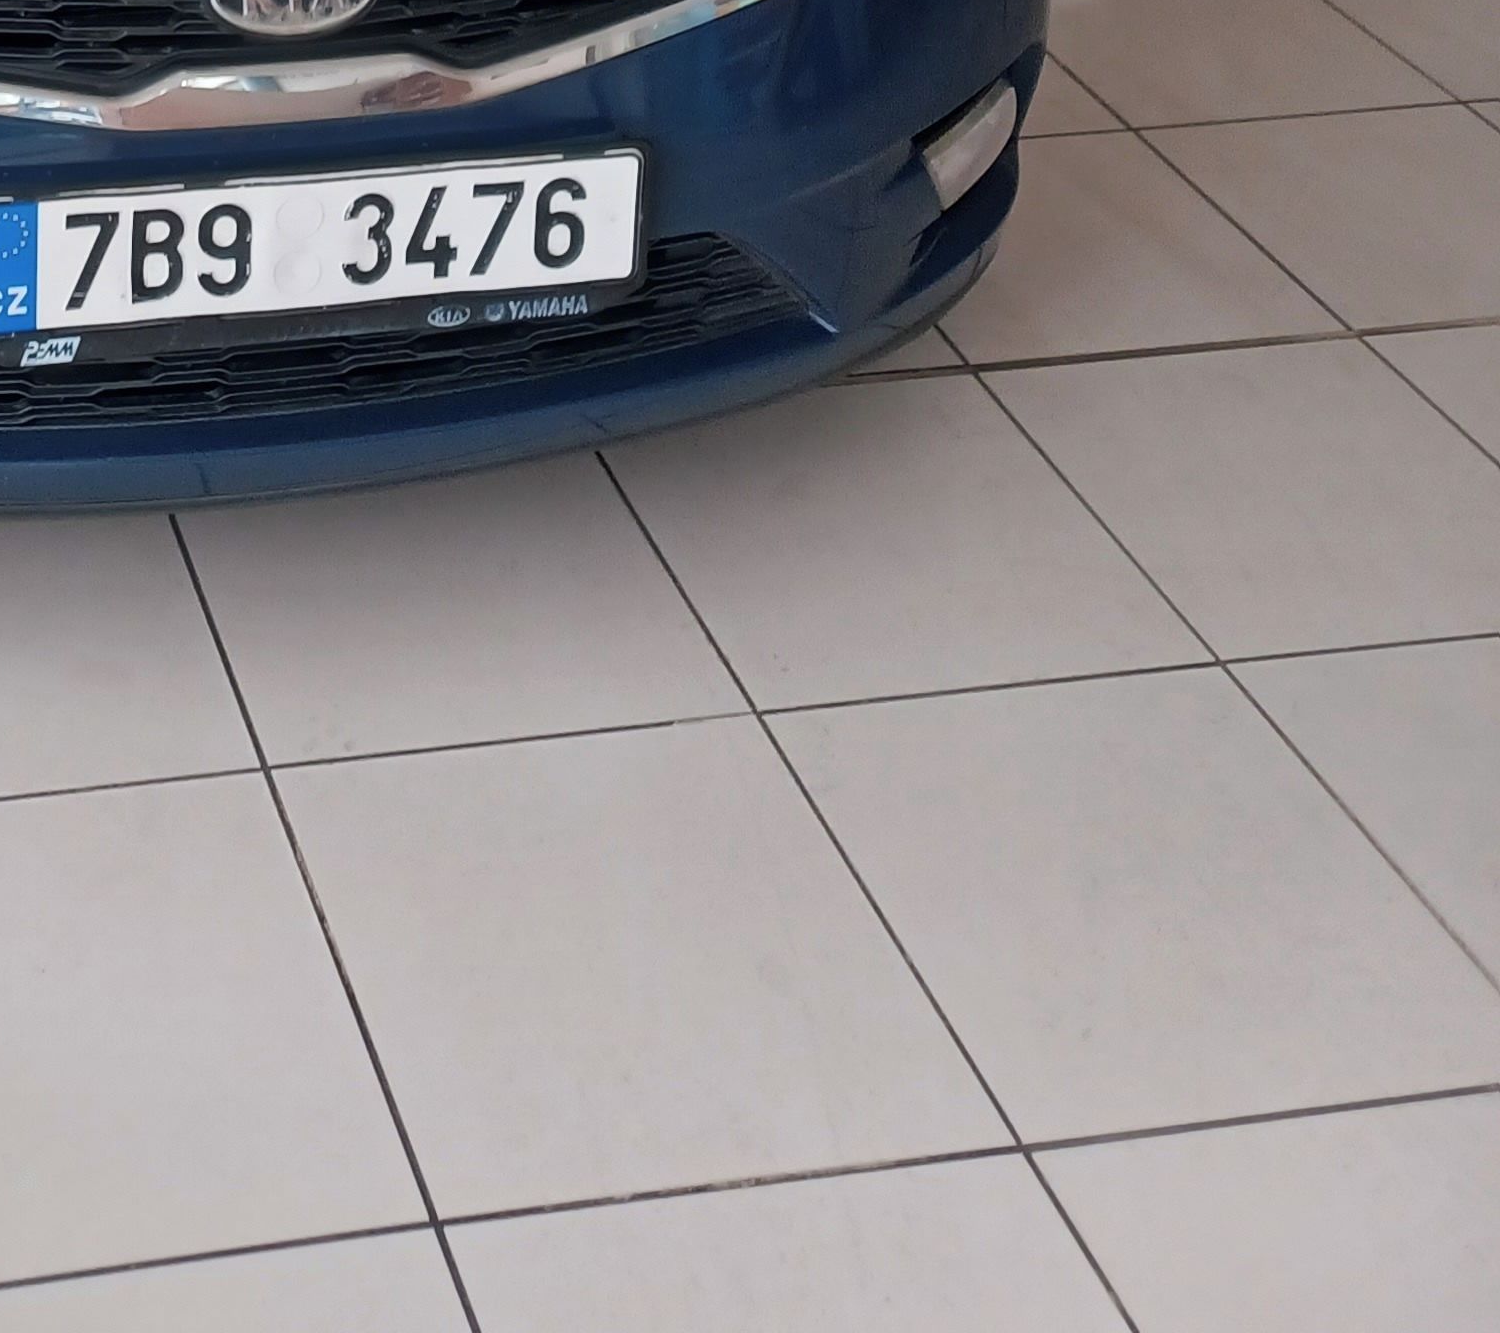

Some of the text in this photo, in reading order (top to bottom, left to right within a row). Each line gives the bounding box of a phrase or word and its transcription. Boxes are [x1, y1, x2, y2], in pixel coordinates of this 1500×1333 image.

[64, 177, 588, 311] 7B9 3476
[509, 294, 589, 321] YAMAHA
